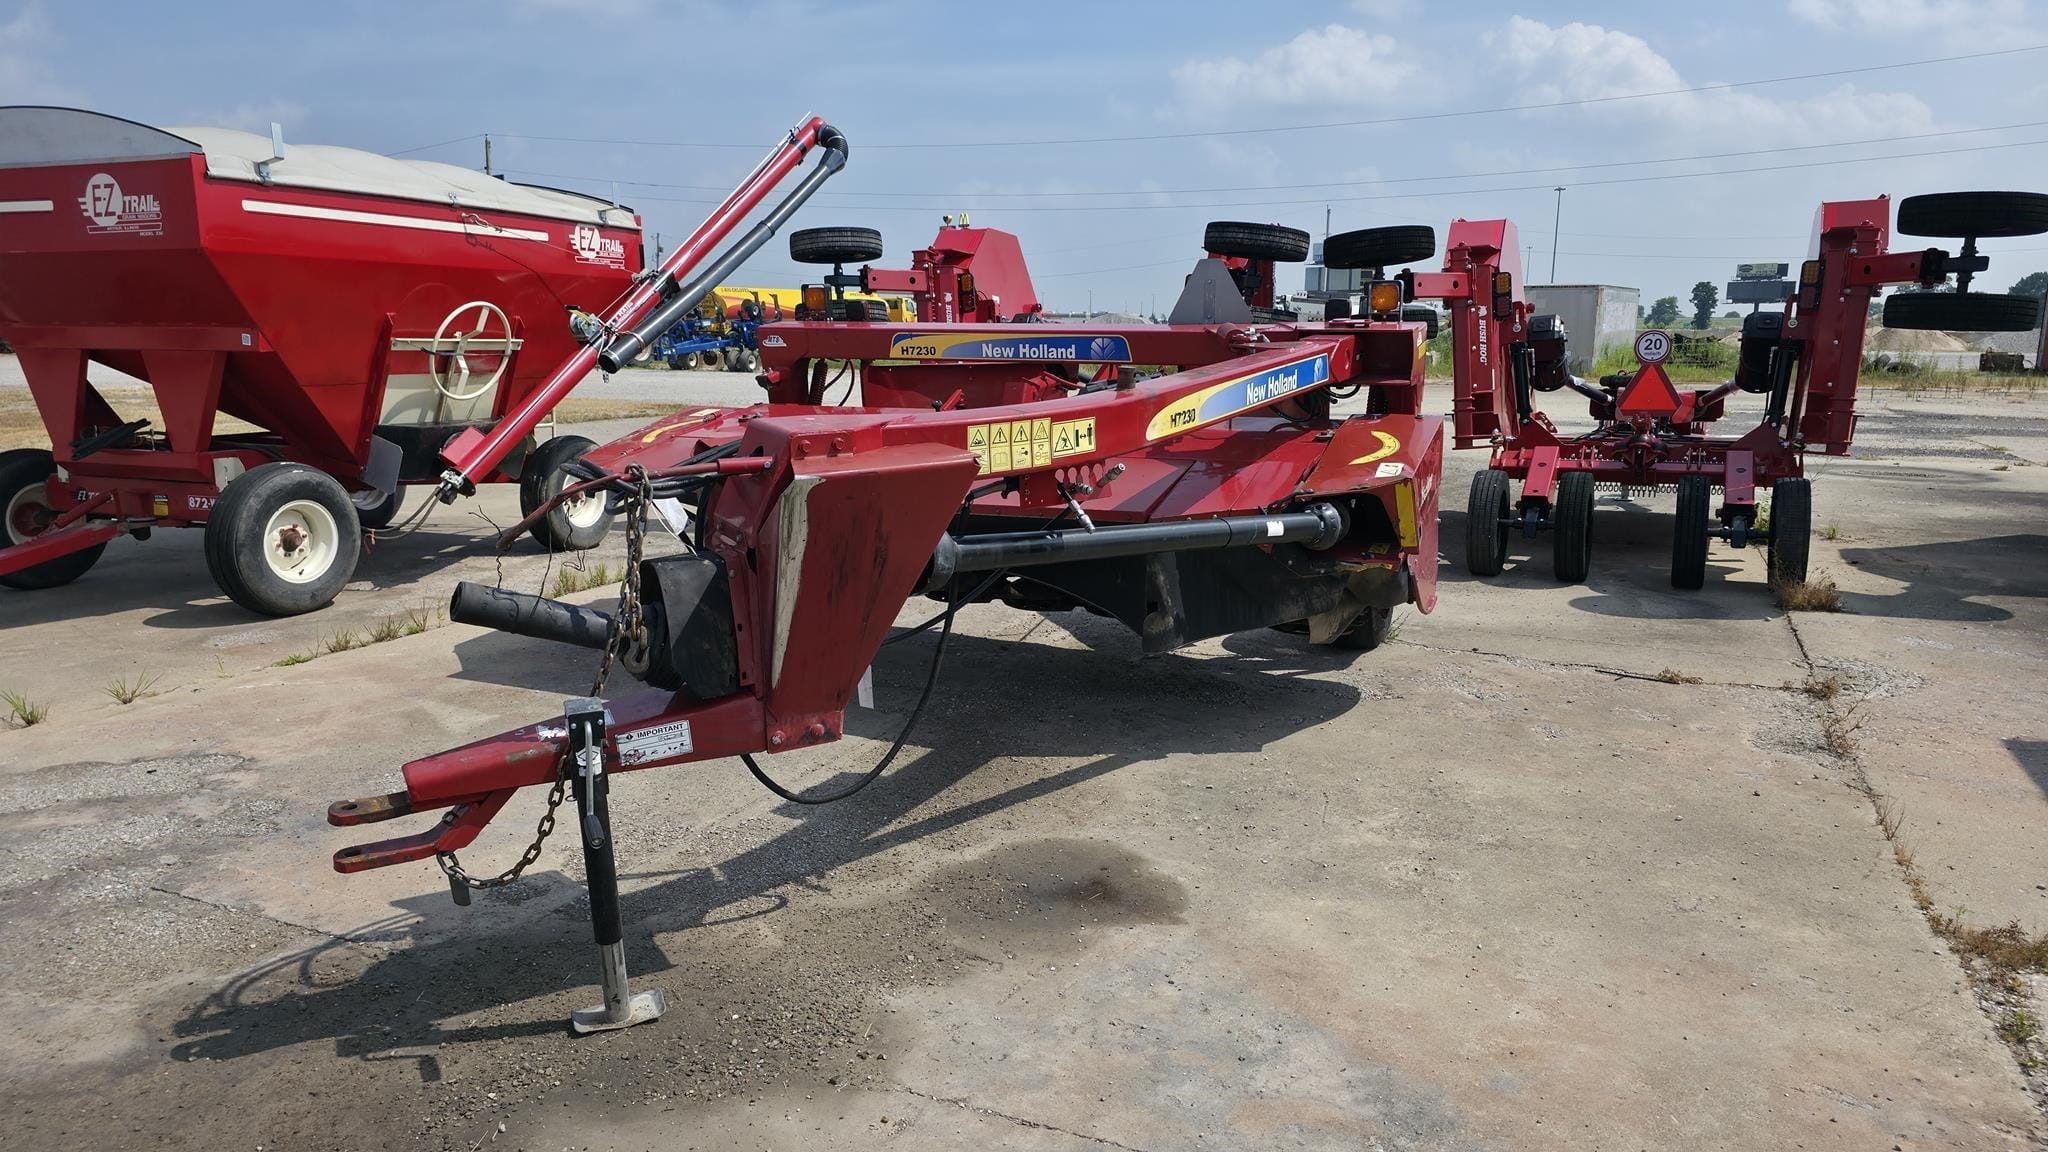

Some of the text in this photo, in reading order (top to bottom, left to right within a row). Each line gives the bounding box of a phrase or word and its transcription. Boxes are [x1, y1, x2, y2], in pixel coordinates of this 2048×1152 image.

[124, 195, 160, 213] TRAIL
[600, 238, 623, 252] TRAIL
[901, 343, 1075, 359] H7230 New Holland
[1644, 338, 1662, 350] 20
[1170, 369, 1297, 428] H7230 New Holland
[637, 723, 684, 738] IMPORTANT
